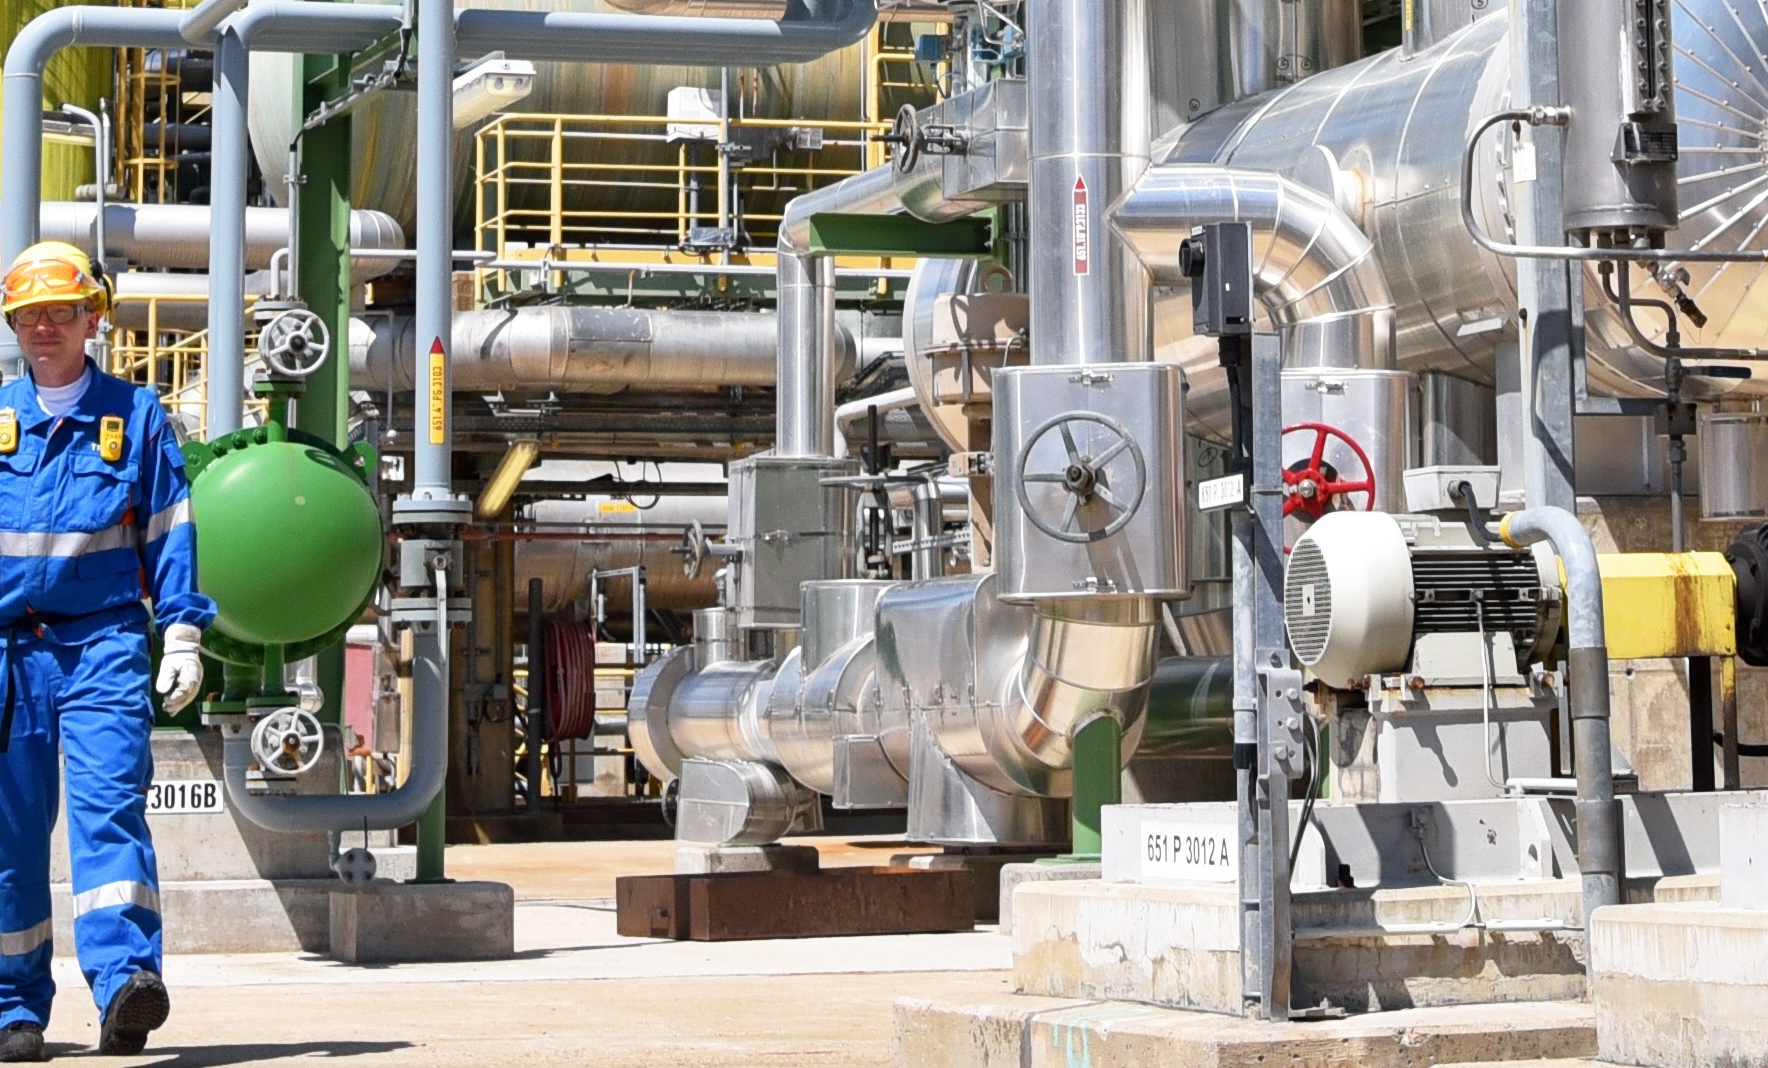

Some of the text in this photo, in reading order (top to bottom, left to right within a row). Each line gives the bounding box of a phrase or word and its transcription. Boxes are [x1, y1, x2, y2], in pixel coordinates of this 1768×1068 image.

[1148, 834, 1230, 867] 651 P 3012 A
